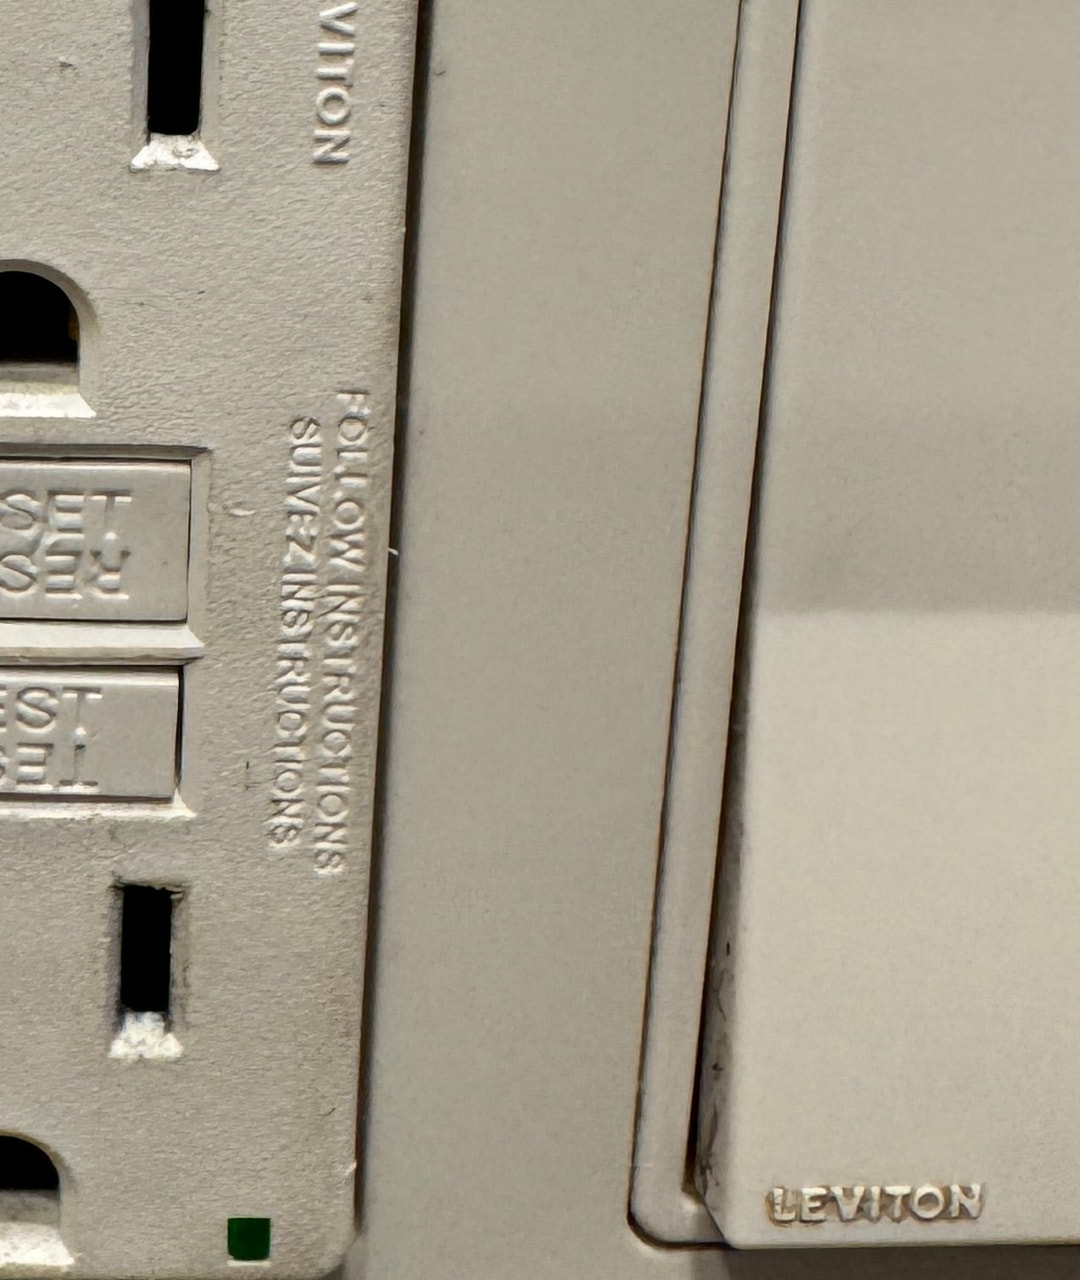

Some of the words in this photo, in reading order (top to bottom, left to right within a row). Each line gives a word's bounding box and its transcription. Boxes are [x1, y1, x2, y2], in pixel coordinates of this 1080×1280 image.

[283, 415, 322, 569] SUIVEZ
[327, 389, 372, 575] FOLLOW
[267, 572, 316, 852] INSTRUCTIONS
[311, 582, 364, 878] INSTRUCTIONS
[766, 1182, 986, 1226] LEVITON
